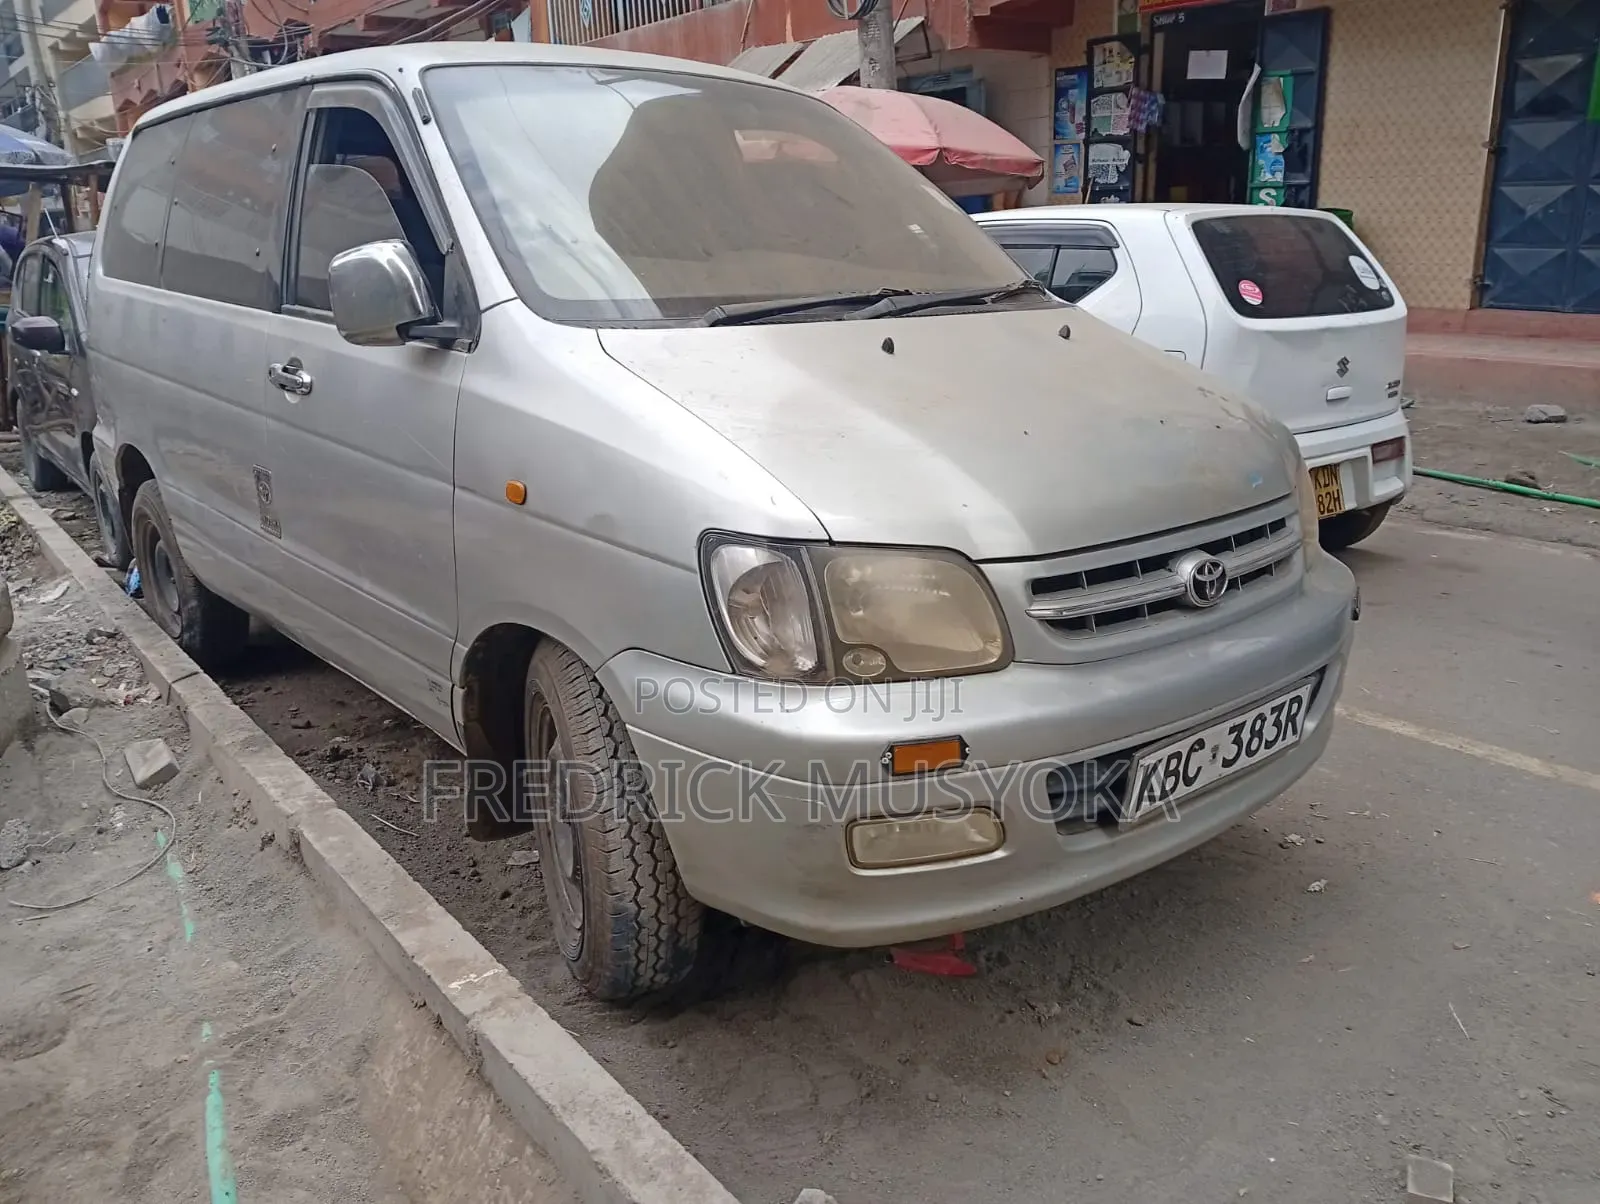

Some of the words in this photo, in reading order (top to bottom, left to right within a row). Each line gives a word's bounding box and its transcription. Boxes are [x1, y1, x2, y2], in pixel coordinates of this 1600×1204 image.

[1178, 13, 1185, 23] 5
[1135, 739, 1206, 808] KBC
[1220, 694, 1304, 768] 383R
